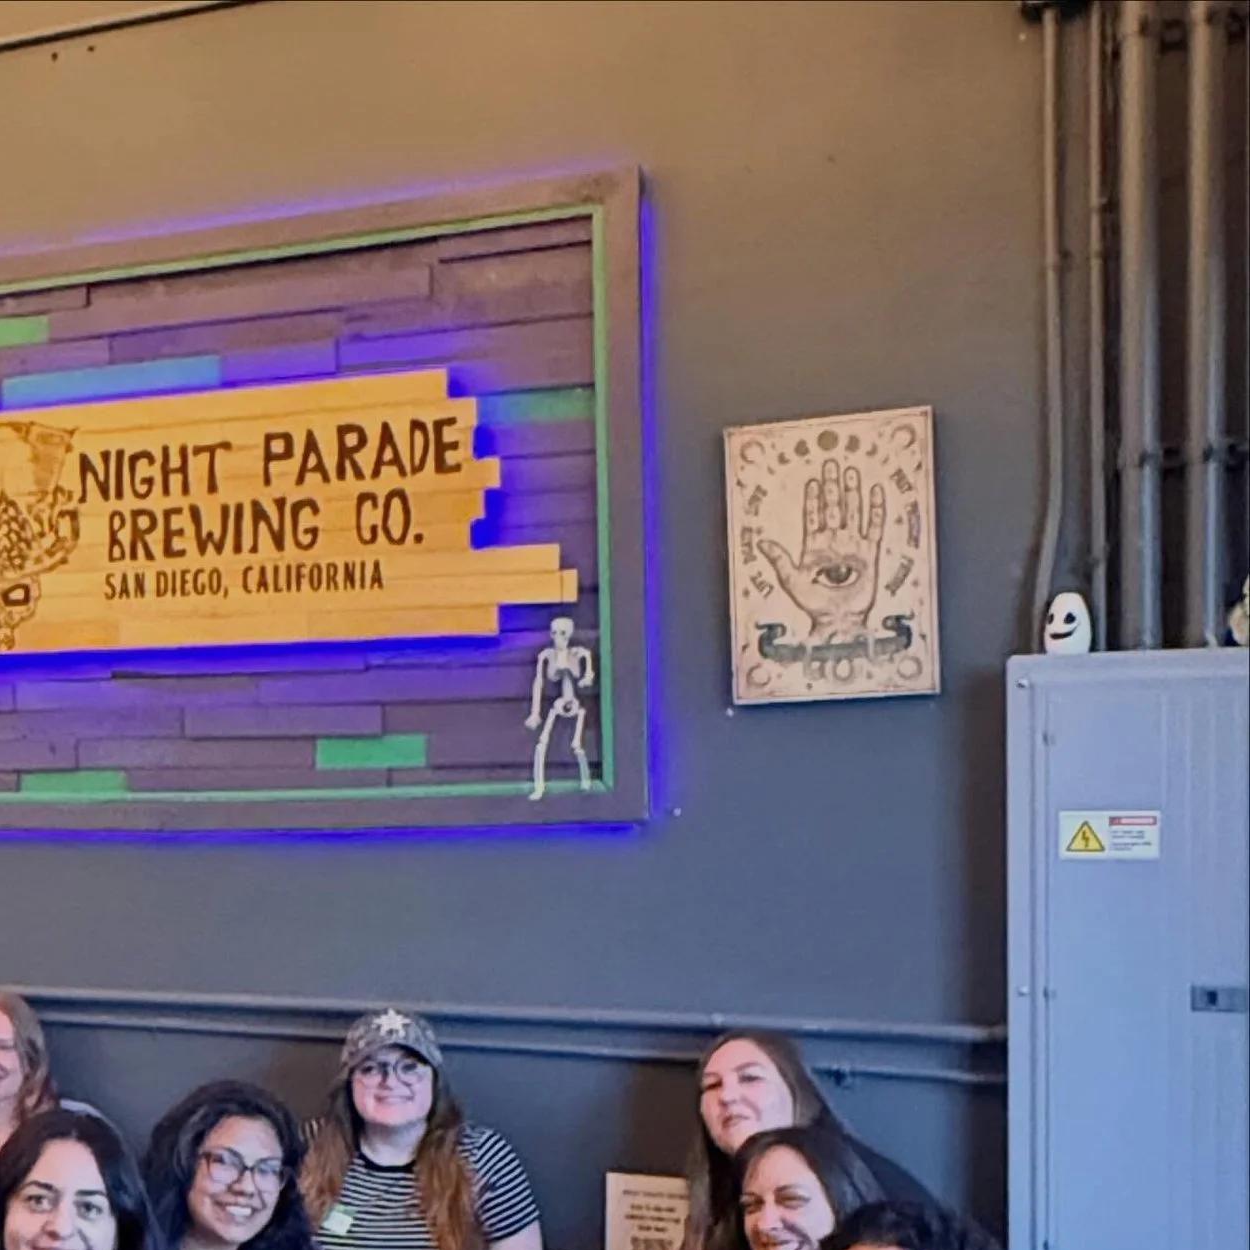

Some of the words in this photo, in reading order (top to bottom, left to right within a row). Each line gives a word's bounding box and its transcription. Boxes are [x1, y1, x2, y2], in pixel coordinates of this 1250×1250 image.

[77, 440, 232, 504] NIGHT
[263, 416, 462, 487] PARADE
[107, 496, 321, 563] BREWING
[355, 487, 424, 545] CO.
[104, 571, 146, 600] SAN
[156, 566, 229, 600] DIEGO,
[241, 559, 385, 594] CALIFORNIA
